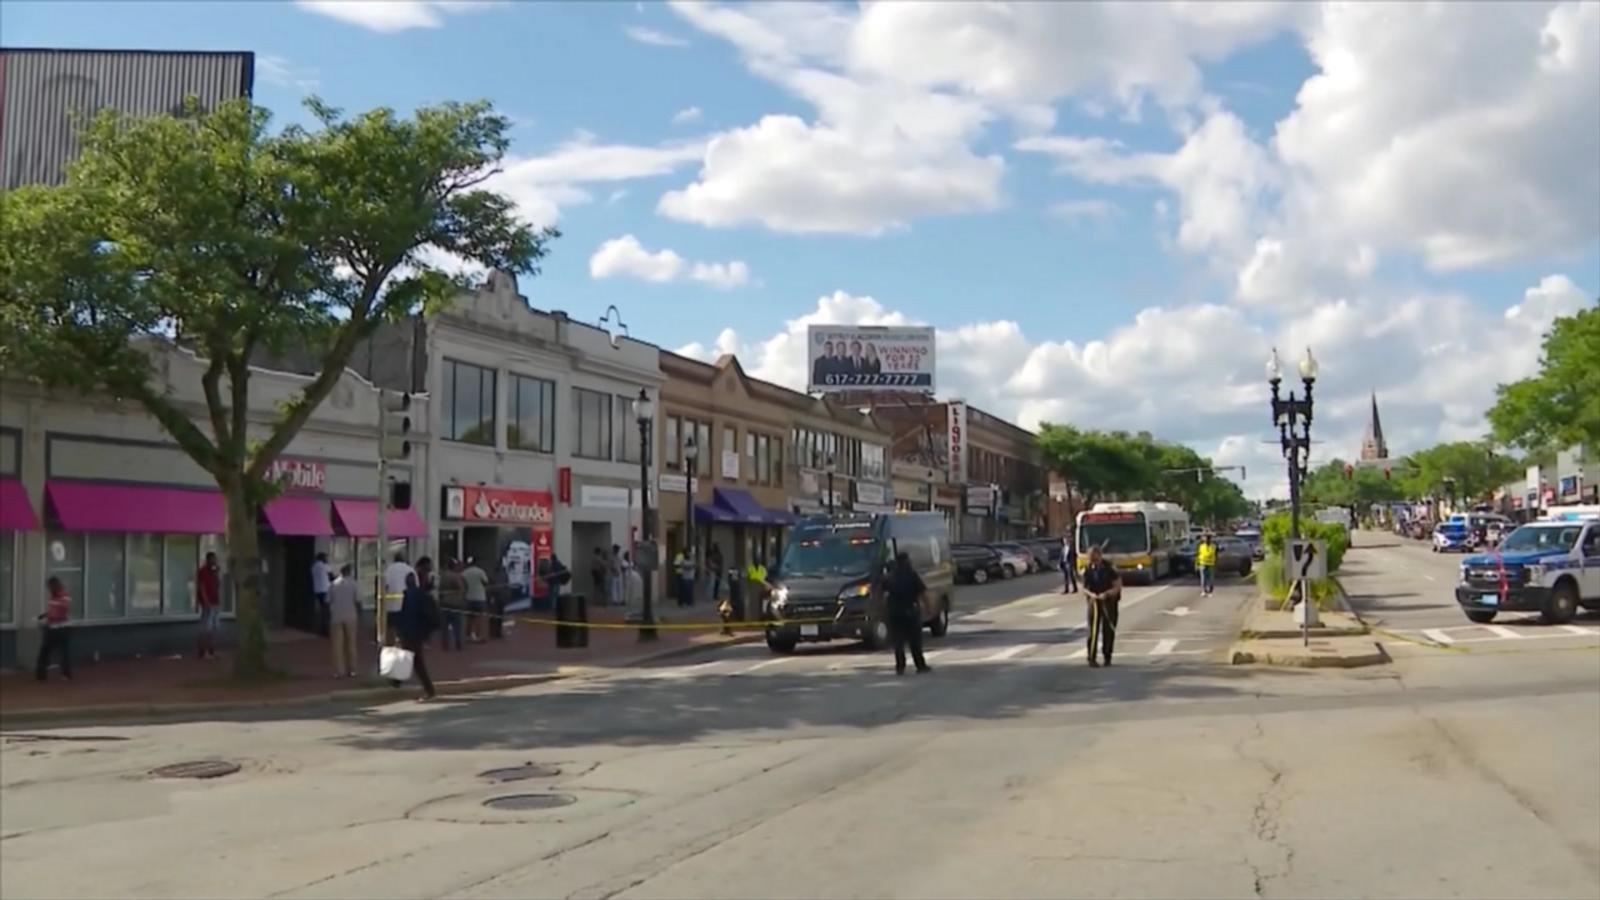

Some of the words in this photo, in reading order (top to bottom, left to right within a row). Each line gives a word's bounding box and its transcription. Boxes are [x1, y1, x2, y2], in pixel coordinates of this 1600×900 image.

[878, 345, 928, 355] WINNING
[885, 353, 905, 362] FOR
[825, 373, 919, 385] 617-777-7777
